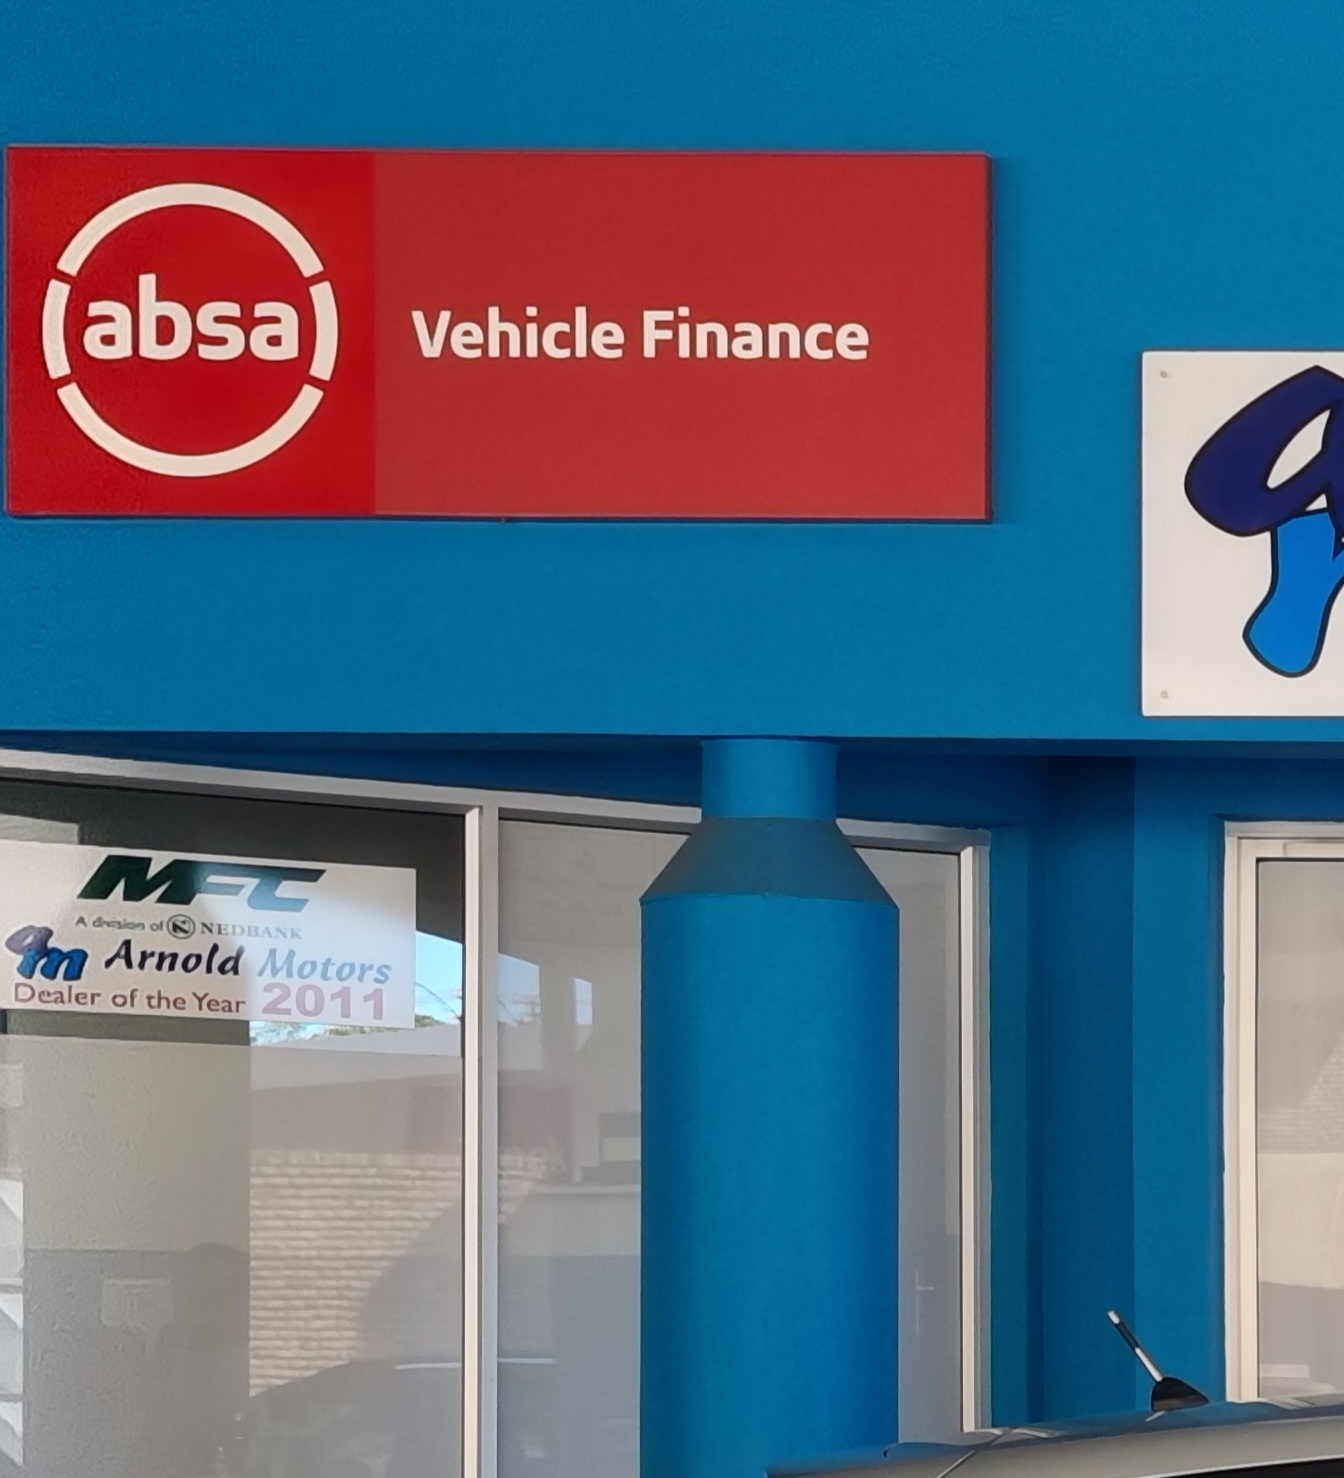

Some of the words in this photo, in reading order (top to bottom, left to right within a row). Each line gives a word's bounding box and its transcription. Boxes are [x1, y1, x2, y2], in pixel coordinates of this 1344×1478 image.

[83, 273, 300, 361] absa
[411, 306, 626, 360] Vehicle
[641, 309, 870, 360] Finance
[77, 855, 327, 913] MFC
[104, 939, 246, 977] Arnold
[257, 948, 392, 985] Motors
[14, 983, 102, 1006] Dealer
[111, 989, 139, 1008] of
[146, 990, 187, 1011] the
[191, 992, 247, 1014] Year
[262, 982, 384, 1020] 2011
